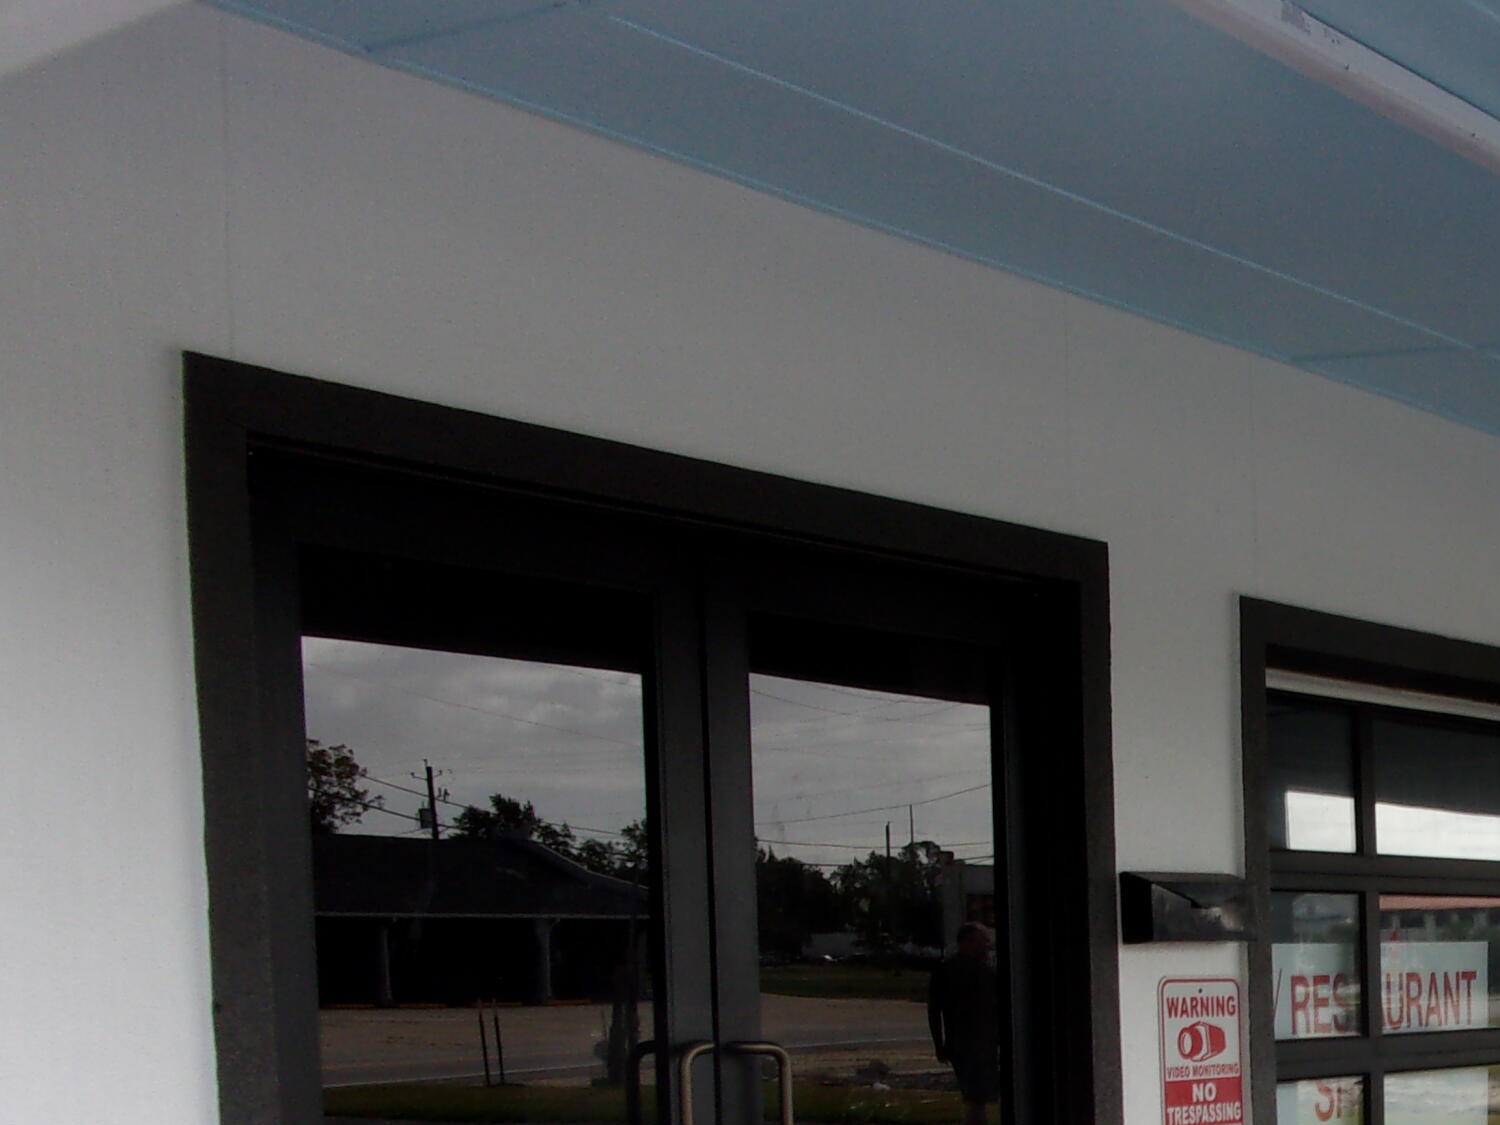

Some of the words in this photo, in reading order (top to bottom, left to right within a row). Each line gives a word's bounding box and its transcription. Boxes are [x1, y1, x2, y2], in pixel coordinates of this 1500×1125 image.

[1166, 995, 1236, 1019] WARNING
[1291, 970, 1477, 1035] RESURANT
[1167, 1065, 1191, 1079] VIDEO
[1192, 1062, 1239, 1077] MONITORING
[1192, 1082, 1217, 1103] NO
